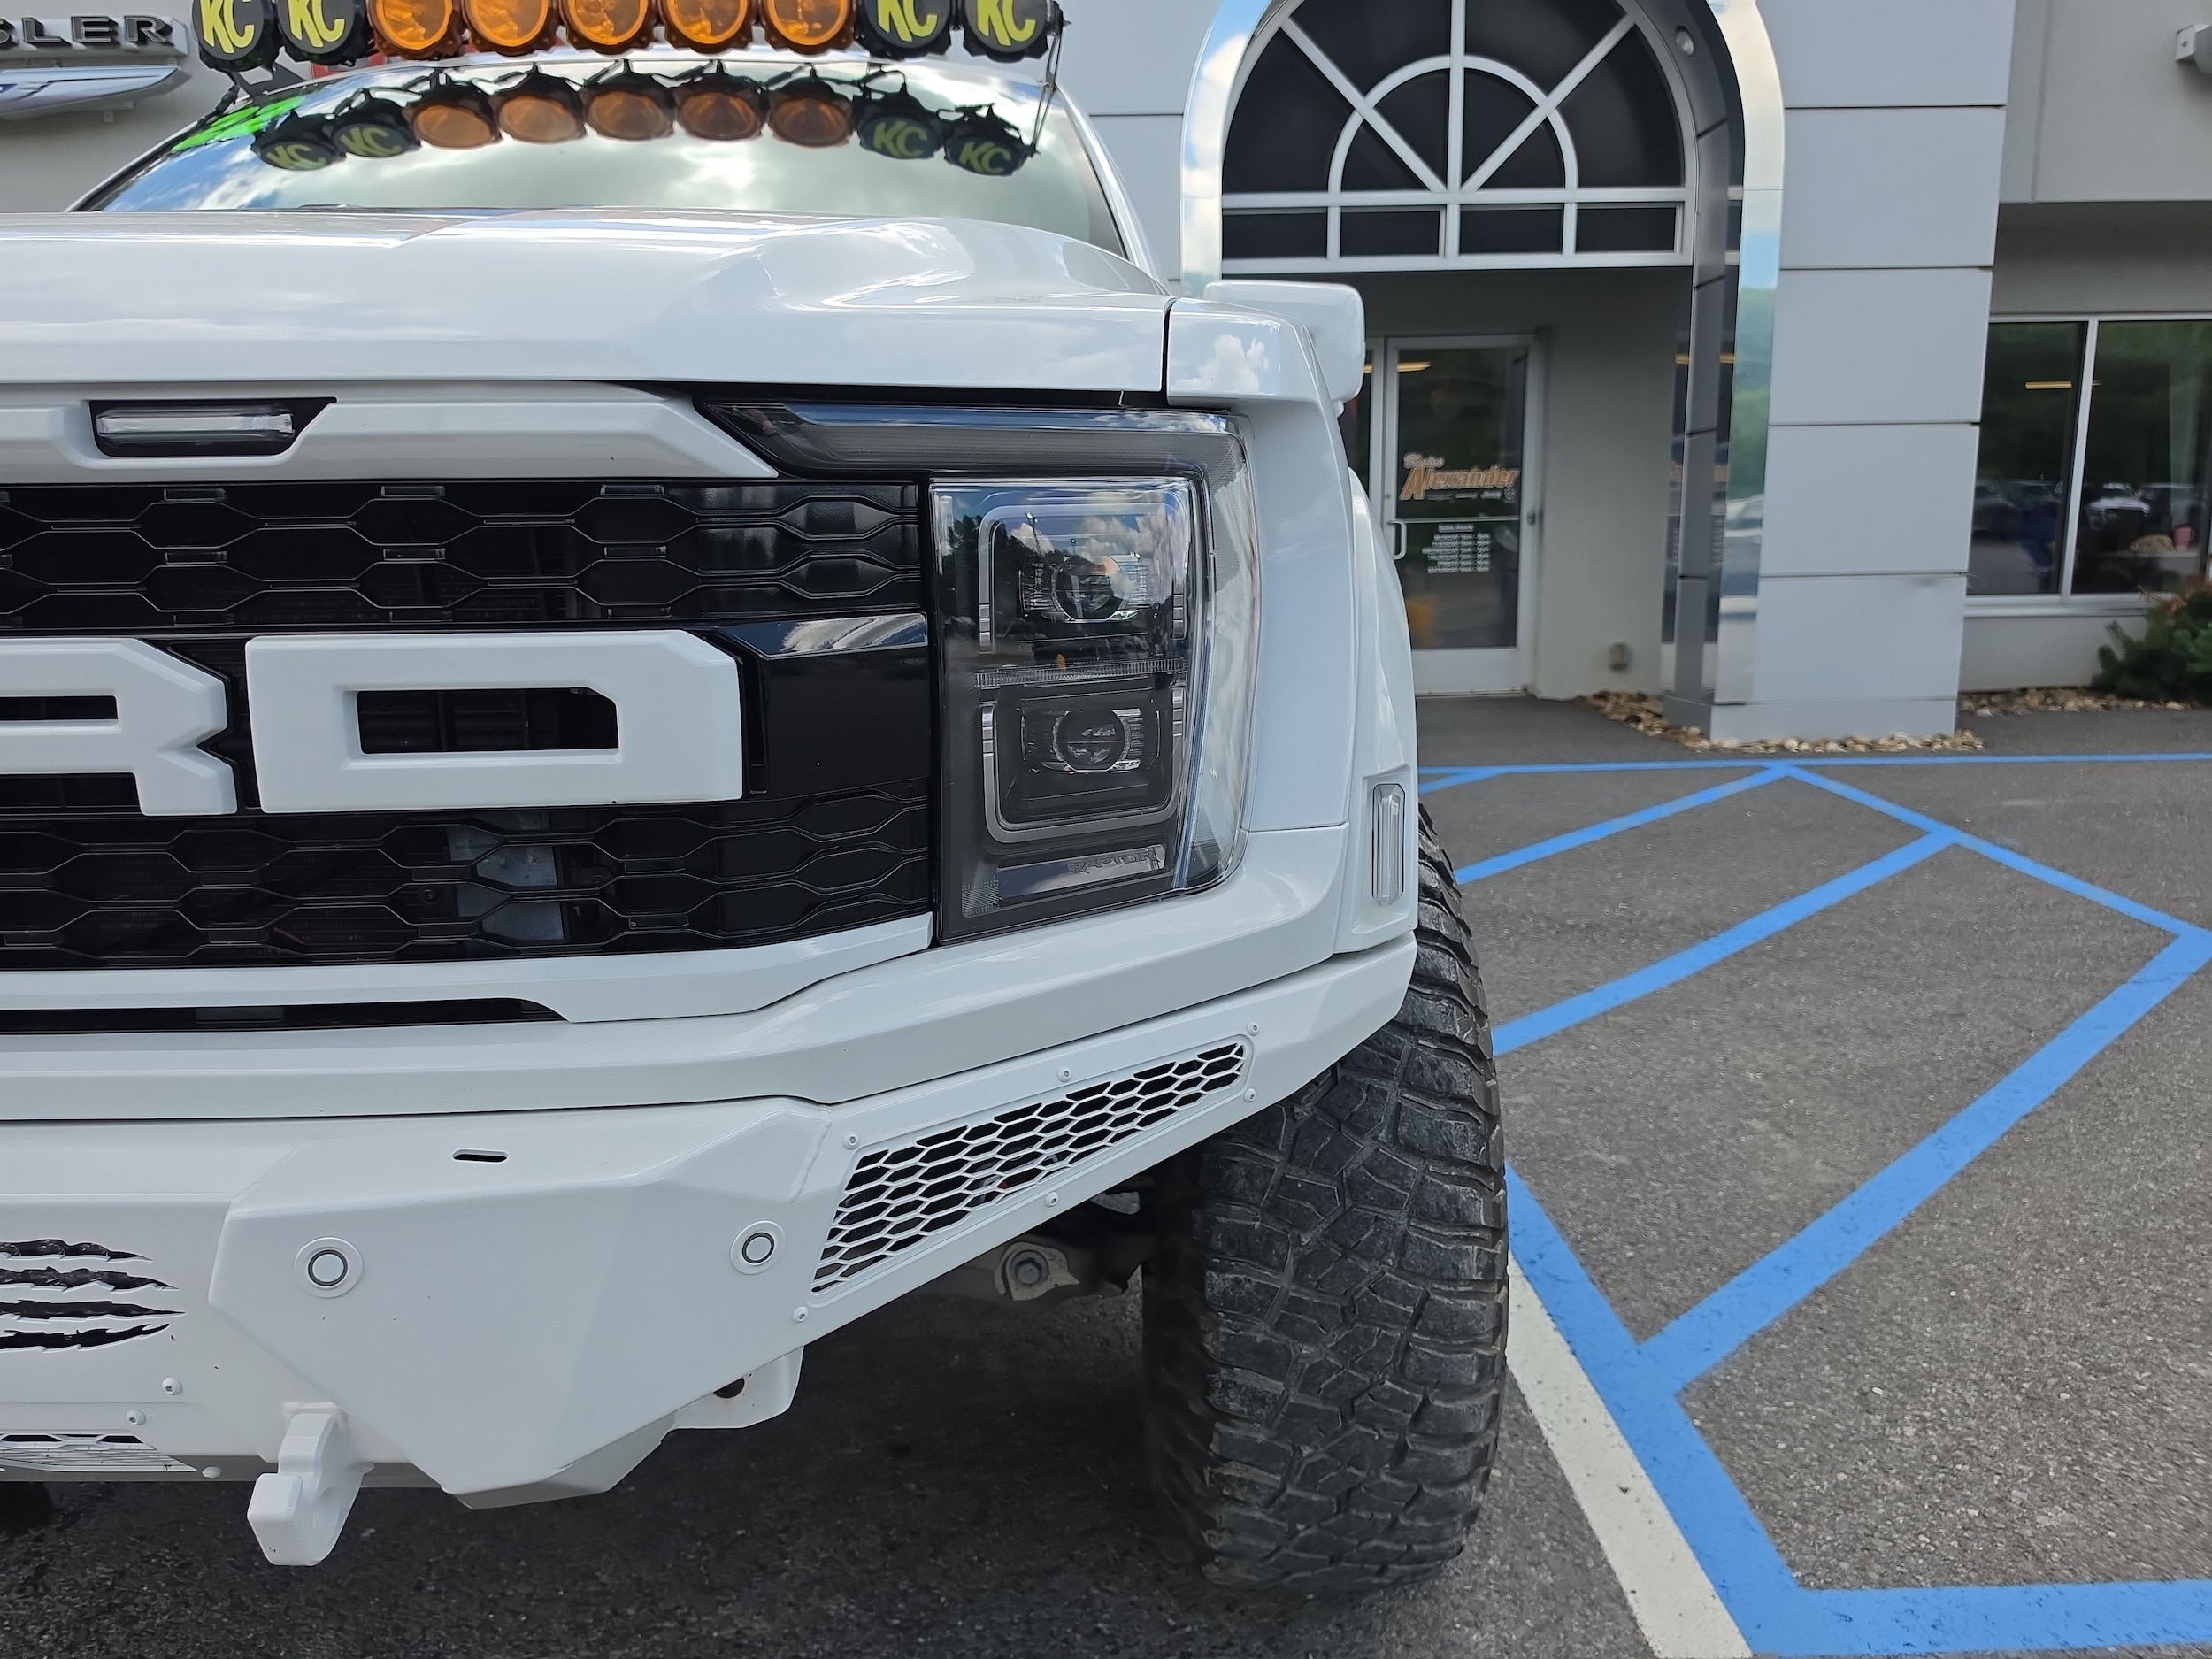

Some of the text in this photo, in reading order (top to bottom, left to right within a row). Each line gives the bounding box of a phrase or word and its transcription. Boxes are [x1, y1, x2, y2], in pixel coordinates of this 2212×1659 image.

[0, 15, 173, 47] LER
[199, 0, 255, 54] KC
[287, 0, 346, 48] KC
[875, 0, 938, 42] KC
[976, 0, 1037, 47] KC
[1399, 464, 1519, 500] Alexander
[1066, 849, 1161, 874] RAPTOR
